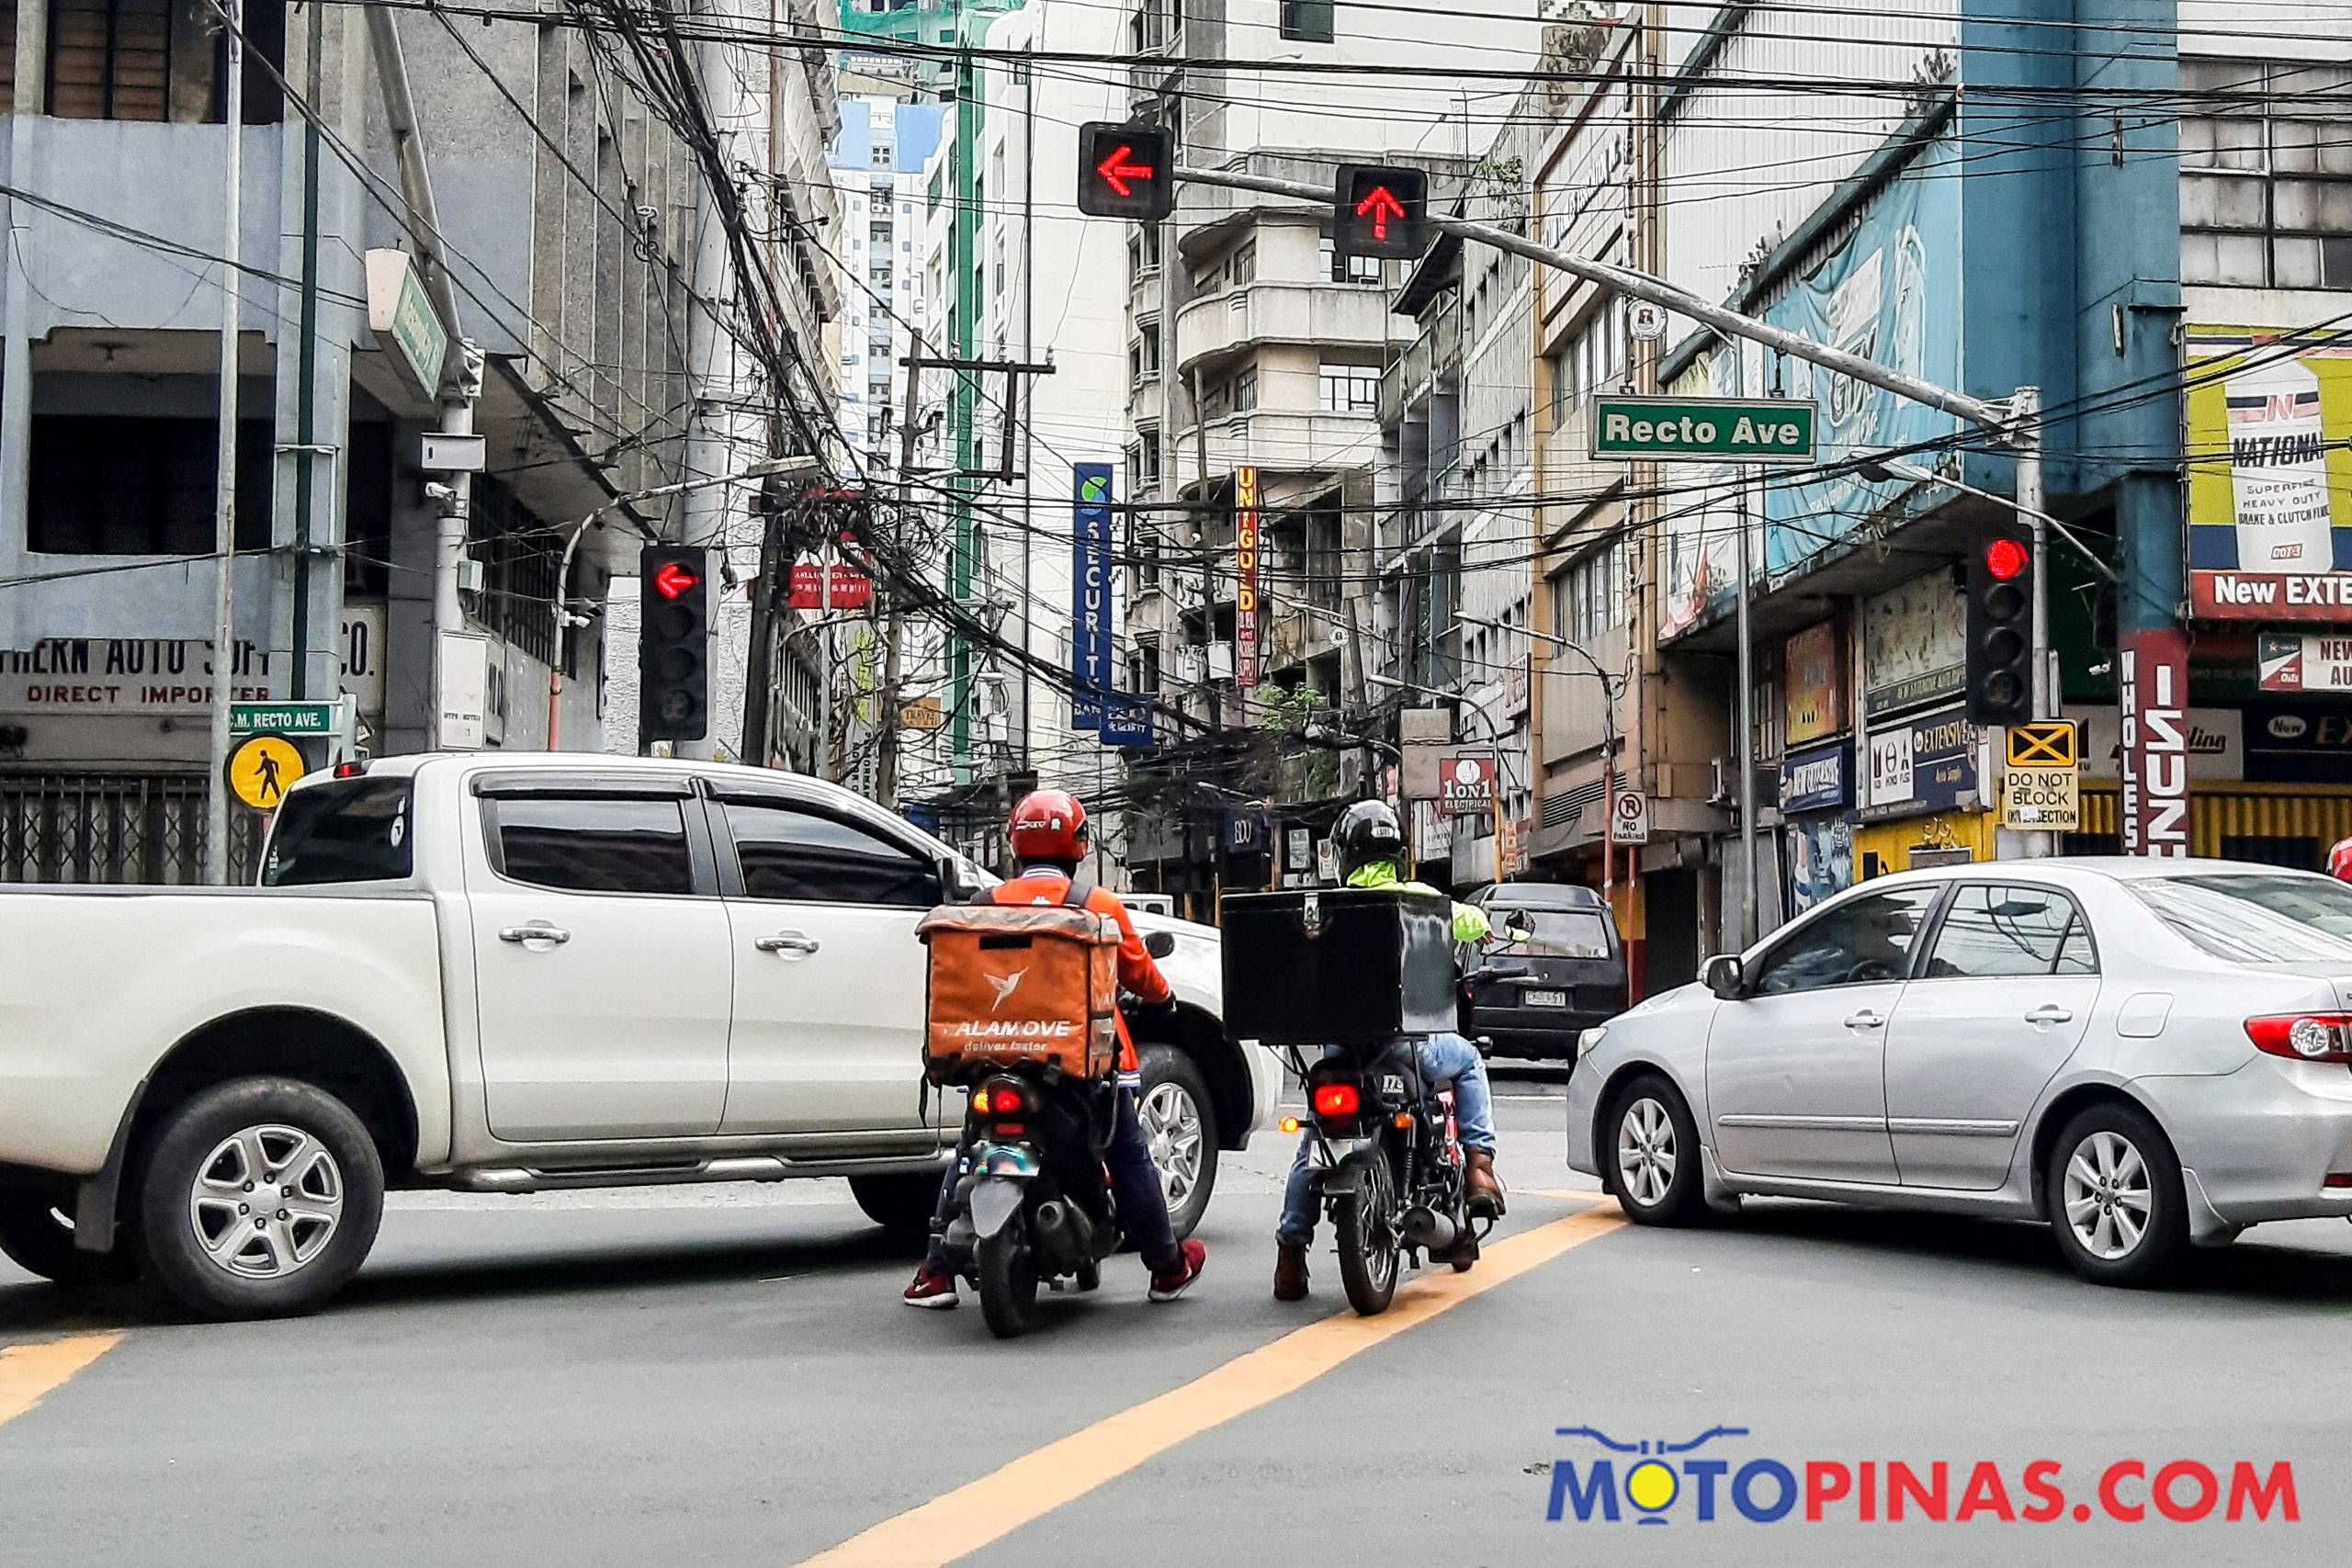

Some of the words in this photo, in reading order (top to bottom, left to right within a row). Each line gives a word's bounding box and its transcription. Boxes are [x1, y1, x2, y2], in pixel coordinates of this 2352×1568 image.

[1606, 413, 1717, 444] Recto
[1731, 416, 1801, 445] Ave
[2243, 498, 2286, 509] HEAVY
[2292, 491, 2321, 505] DUTY
[2214, 575, 2277, 604] New
[2286, 576, 2352, 605] EXTE
[1085, 521, 1102, 690] SECURIT
[28, 686, 121, 704] DIRECT
[141, 686, 269, 704] IMPOER
[254, 712, 293, 728] RECTO
[295, 712, 322, 728] AVE.
[2120, 650, 2138, 857] WHOLES
[2008, 773, 2033, 787] DO
[2038, 773, 2073, 787] NOT
[2013, 791, 2069, 806] BLOCK
[944, 1020, 1071, 1037] ALAMOVE
